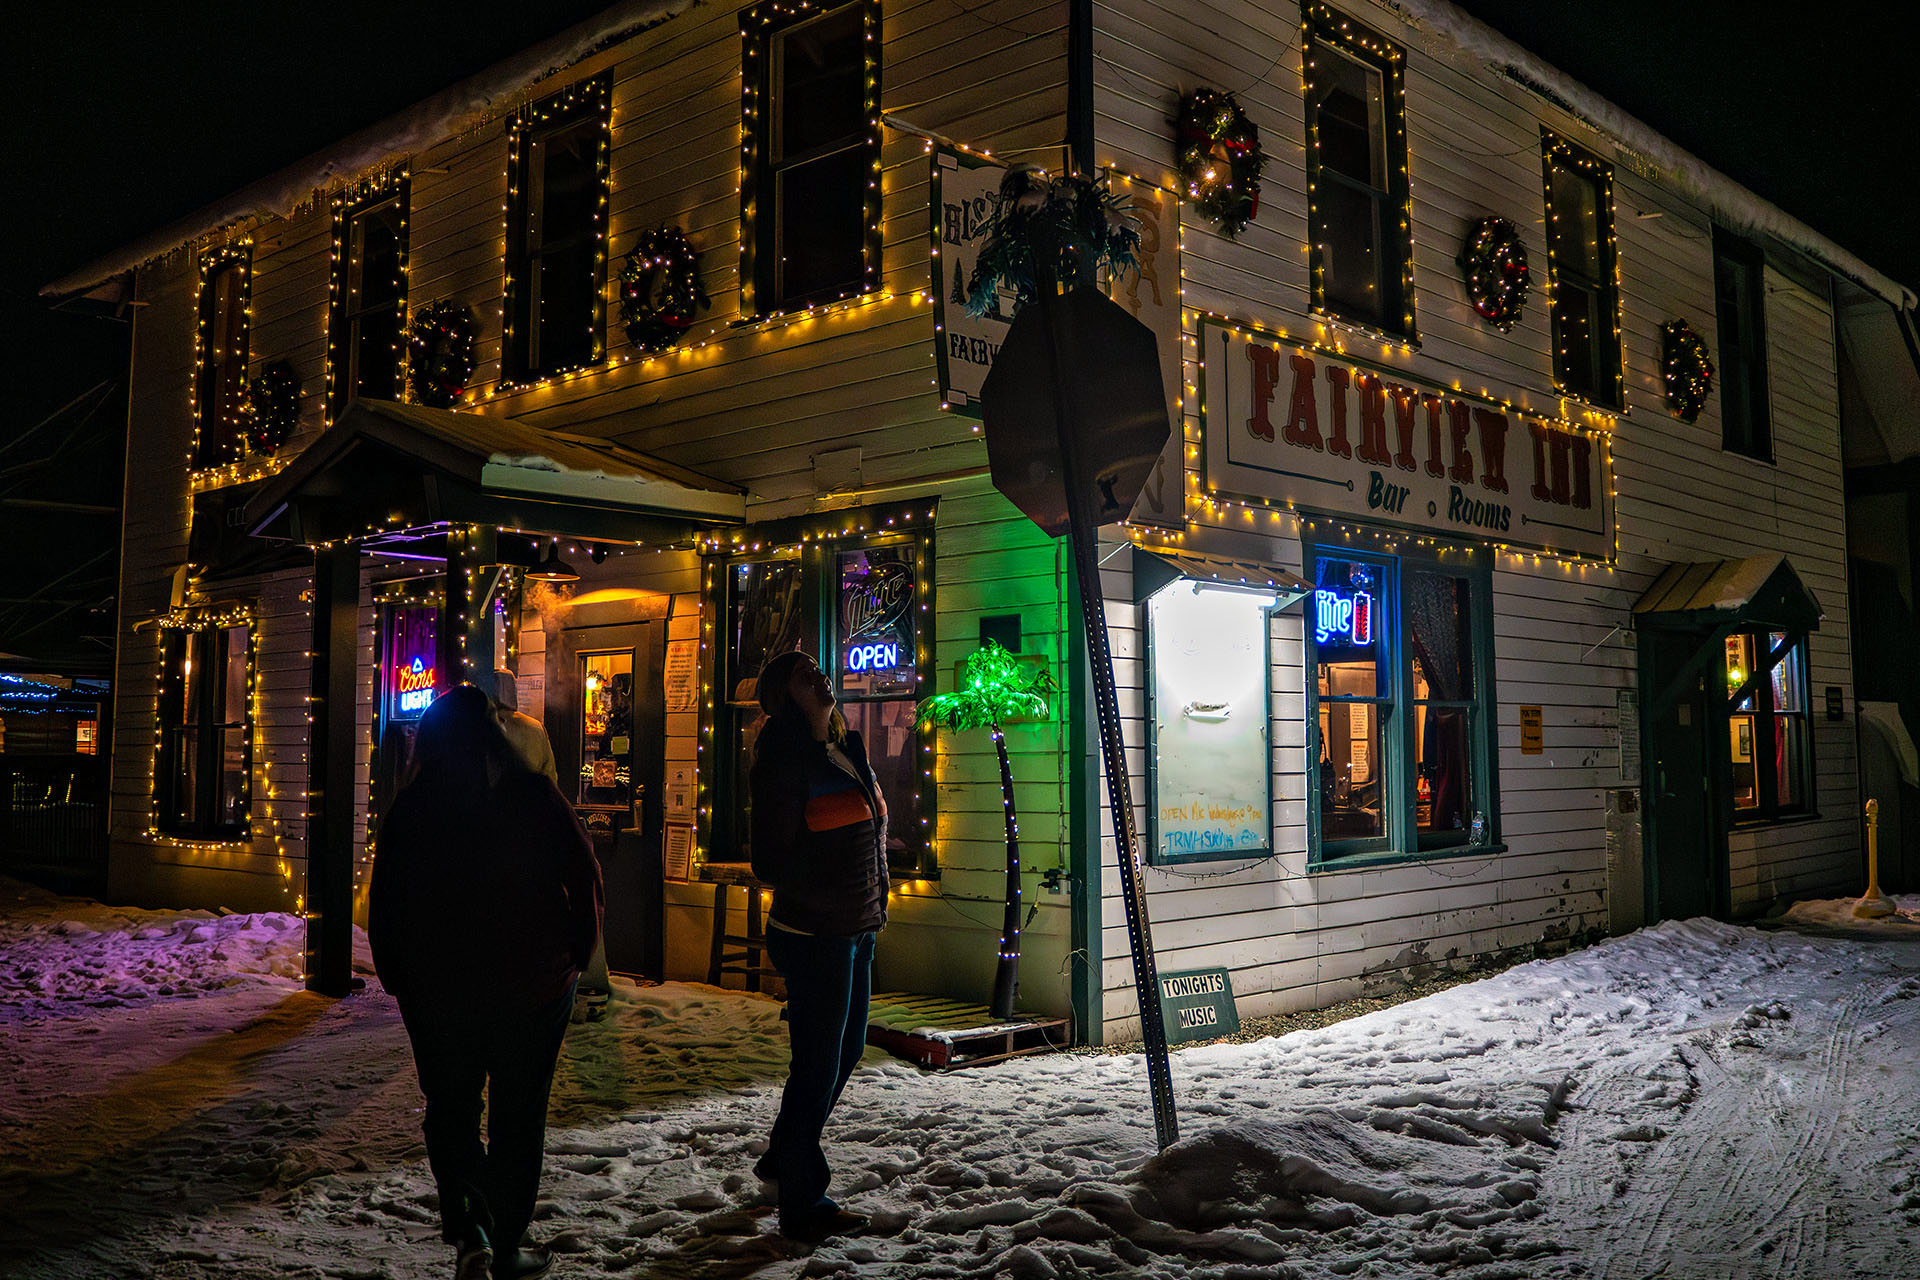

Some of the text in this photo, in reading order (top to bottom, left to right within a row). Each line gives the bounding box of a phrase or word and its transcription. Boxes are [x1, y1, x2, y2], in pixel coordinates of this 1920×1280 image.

[1246, 343, 1509, 494] FAIRVIEW
[1528, 422, 1591, 509] INN
[1367, 471, 1511, 532] Bar Rooms
[849, 643, 897, 670] OPEN
[400, 665, 434, 692] Coors
[402, 689, 433, 711] LIGHT
[1163, 974, 1223, 997] TONIGHTS
[1180, 1006, 1215, 1027] MUSIC
